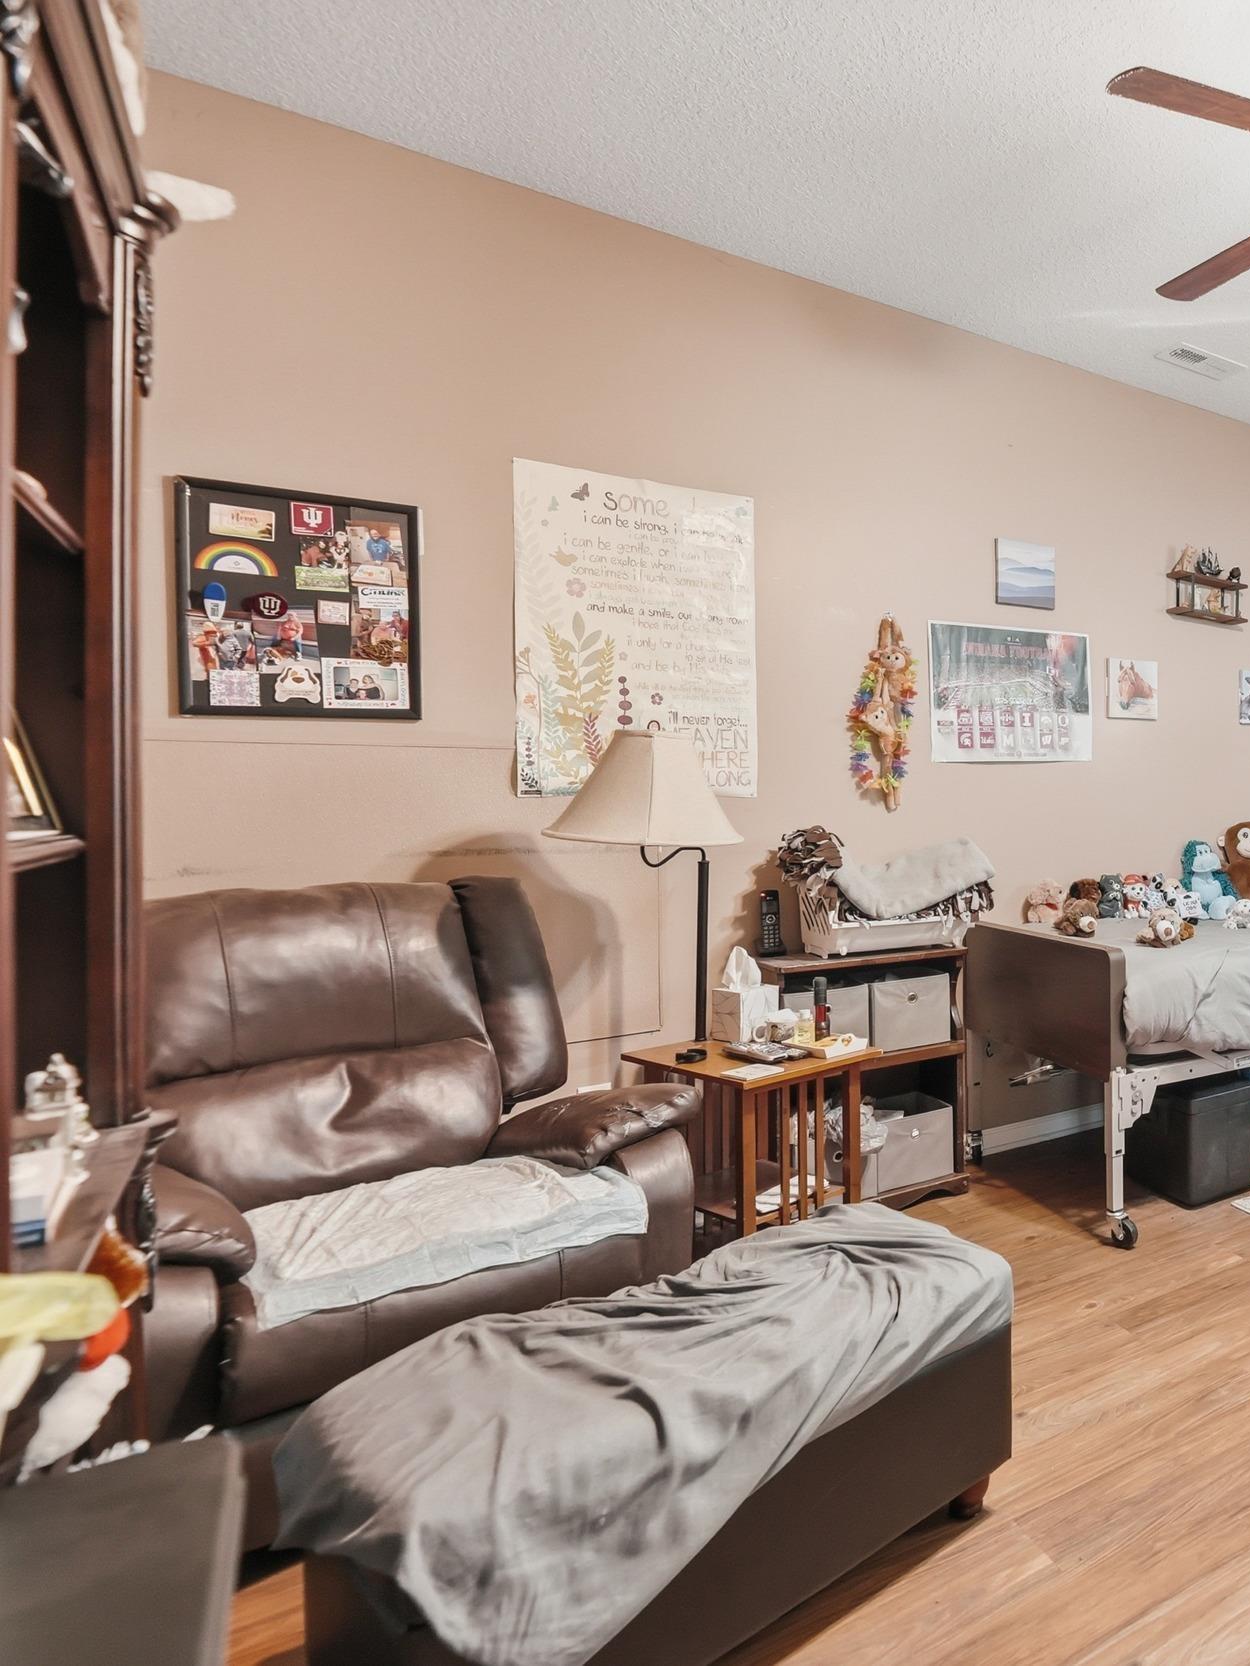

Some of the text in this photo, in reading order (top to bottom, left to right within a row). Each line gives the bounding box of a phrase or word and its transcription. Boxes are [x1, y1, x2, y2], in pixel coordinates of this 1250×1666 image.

[615, 514, 630, 529] be
[608, 603, 634, 615] make
[682, 715, 710, 726] never
[699, 751, 750, 769] HERE
